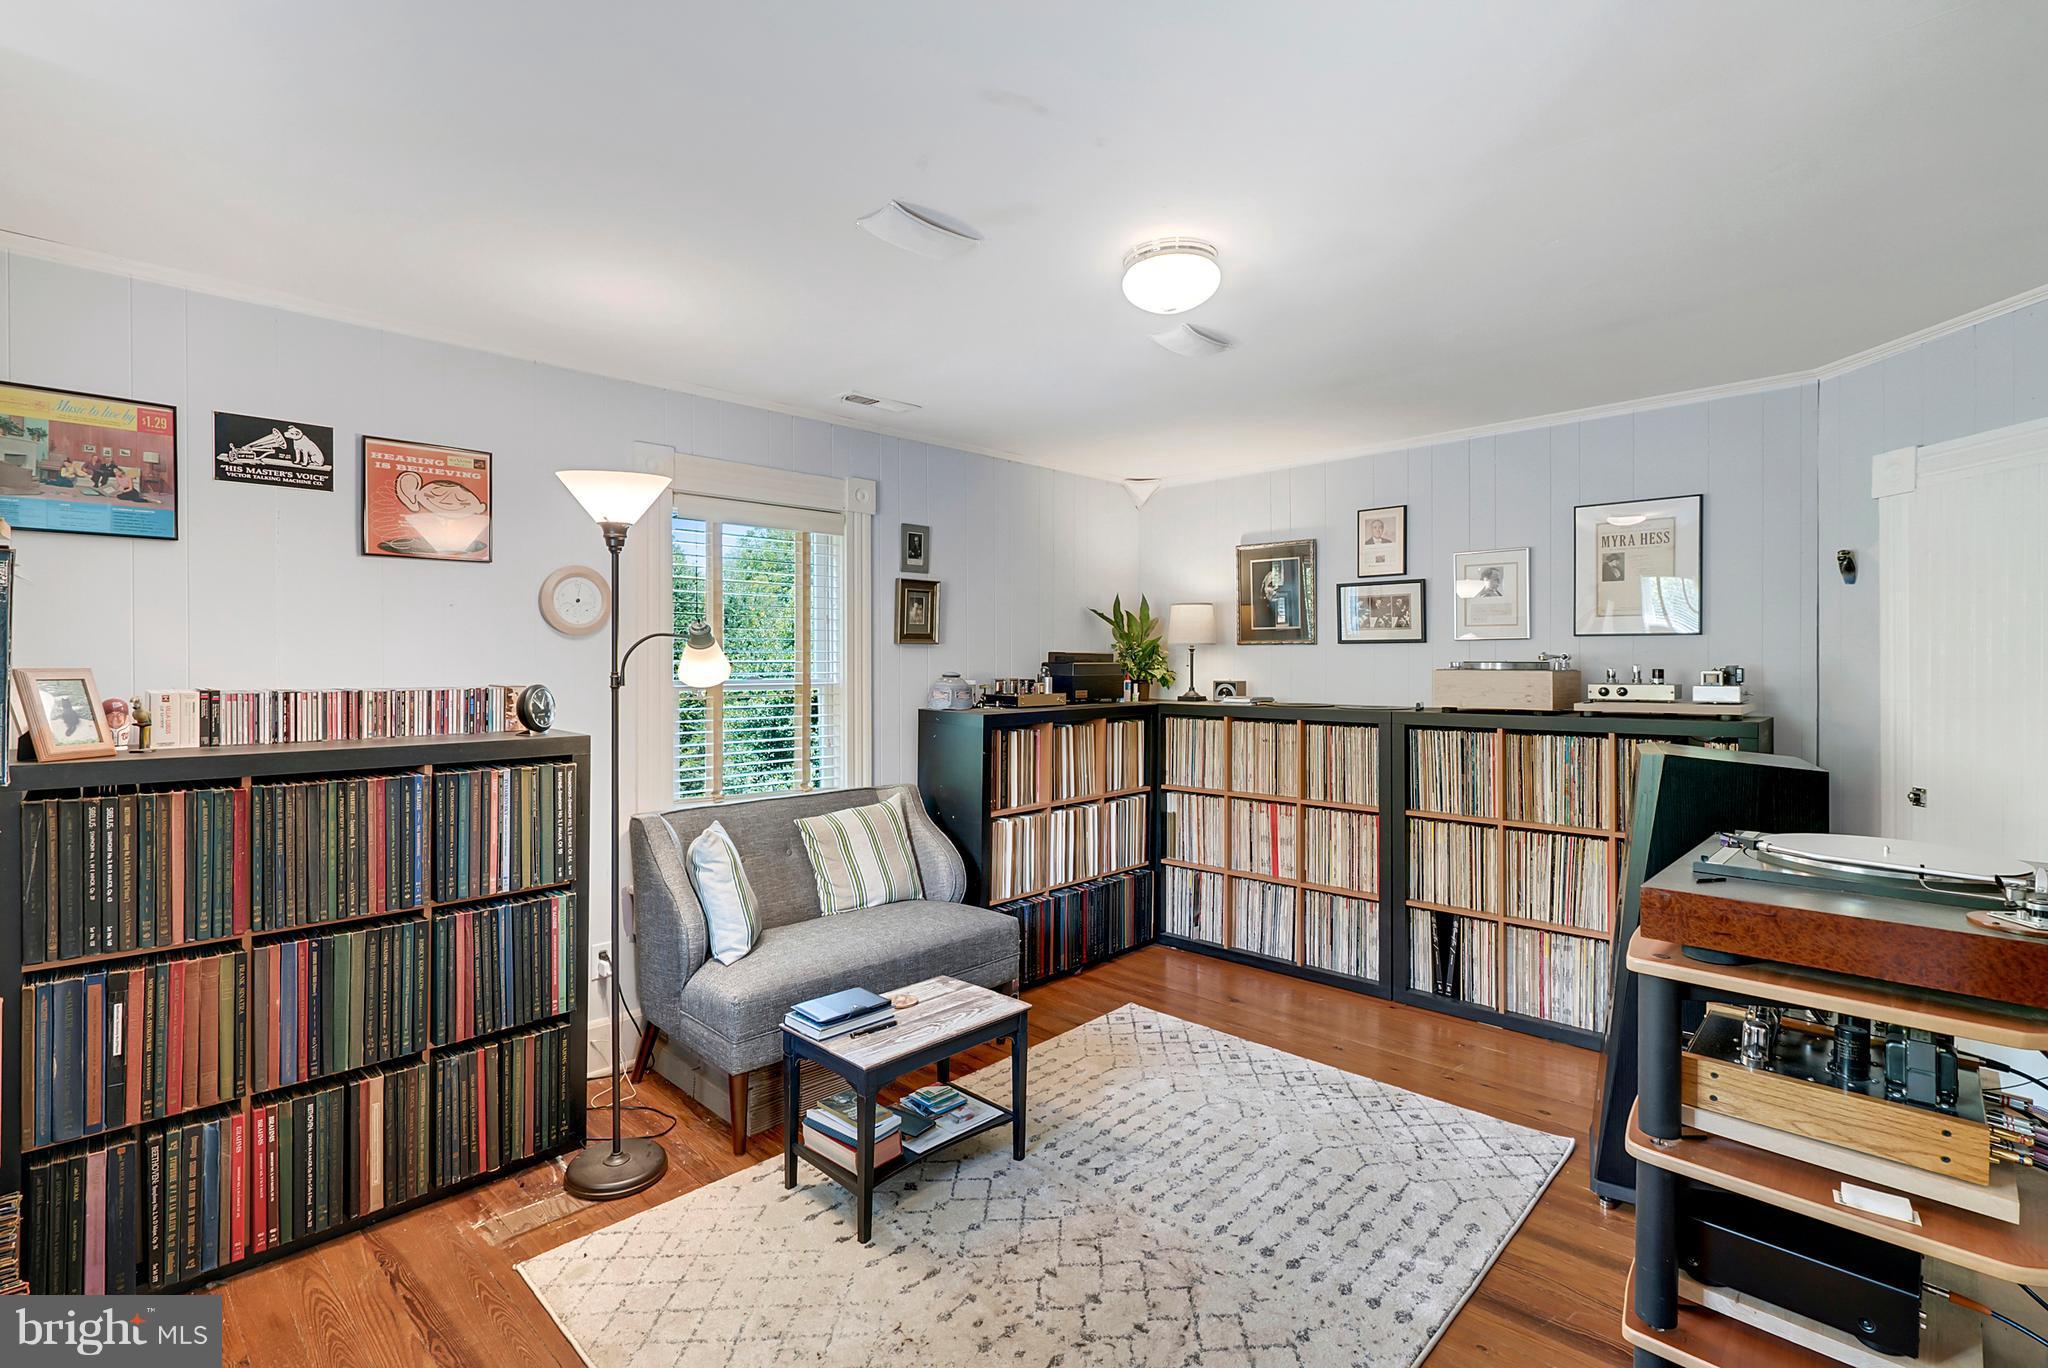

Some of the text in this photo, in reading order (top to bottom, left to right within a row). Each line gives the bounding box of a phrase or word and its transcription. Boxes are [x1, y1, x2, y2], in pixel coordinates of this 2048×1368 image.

[55, 399, 86, 415] Music
[89, 406, 99, 417] to
[123, 408, 136, 424] by
[142, 415, 168, 430] $1.29
[370, 451, 445, 467] HEARING
[220, 464, 329, 482] "HIS MASTER'S VOICE"
[226, 471, 252, 479] VICTOR
[253, 474, 281, 482] TALKING
[282, 477, 312, 486] MACHINE
[375, 461, 481, 480] IS BELIEVING
[1601, 531, 1670, 548] MYRA HESS
[151, 1146, 159, 1184] BEETHOVEN:
